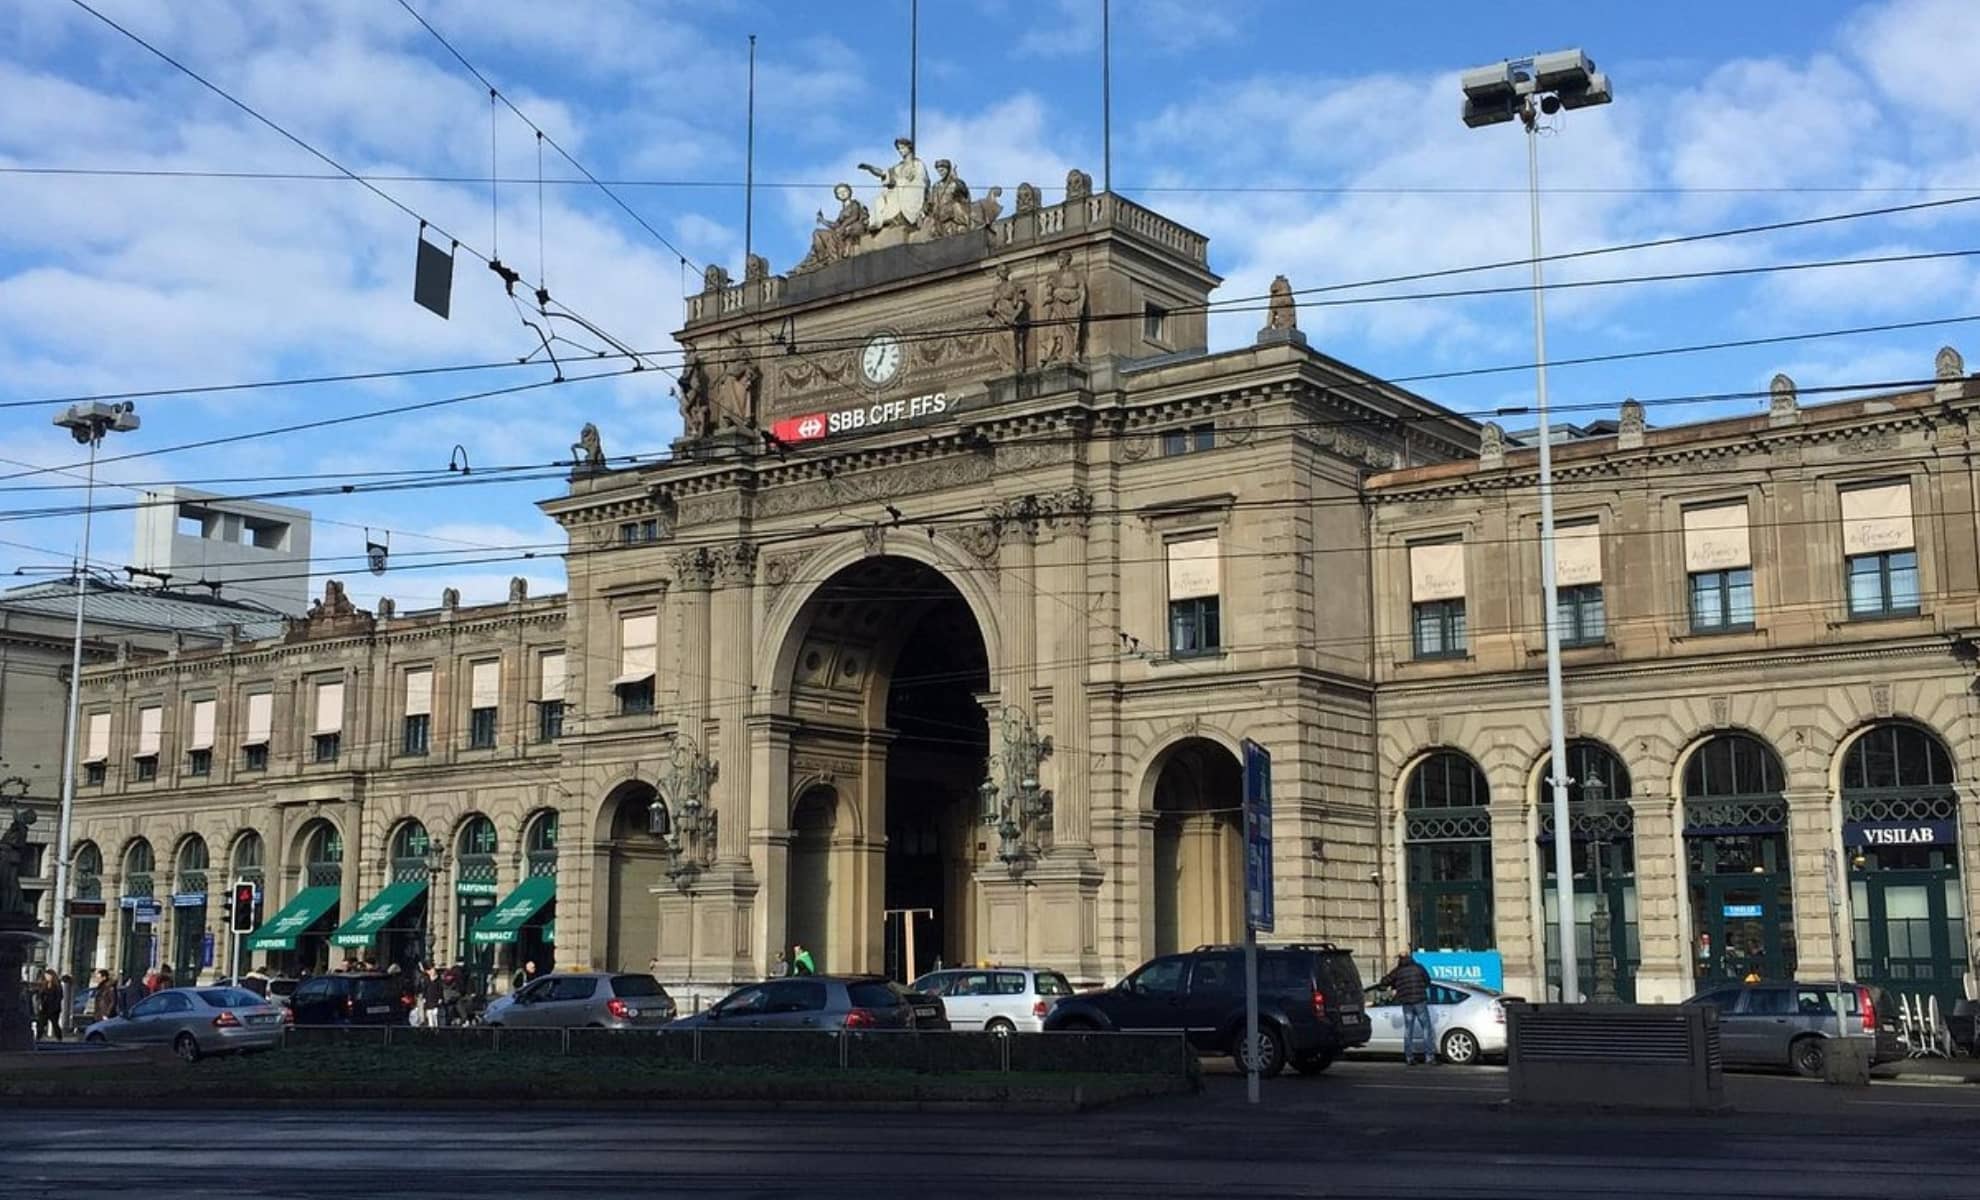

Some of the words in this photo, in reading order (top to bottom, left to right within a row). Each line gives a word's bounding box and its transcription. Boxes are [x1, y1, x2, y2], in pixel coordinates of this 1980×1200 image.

[829, 408, 866, 432] SBB
[870, 400, 906, 425] CFF
[910, 393, 946, 418] FFS
[1863, 827, 1934, 843] VISILAB
[1431, 965, 1482, 978] VISILAB
